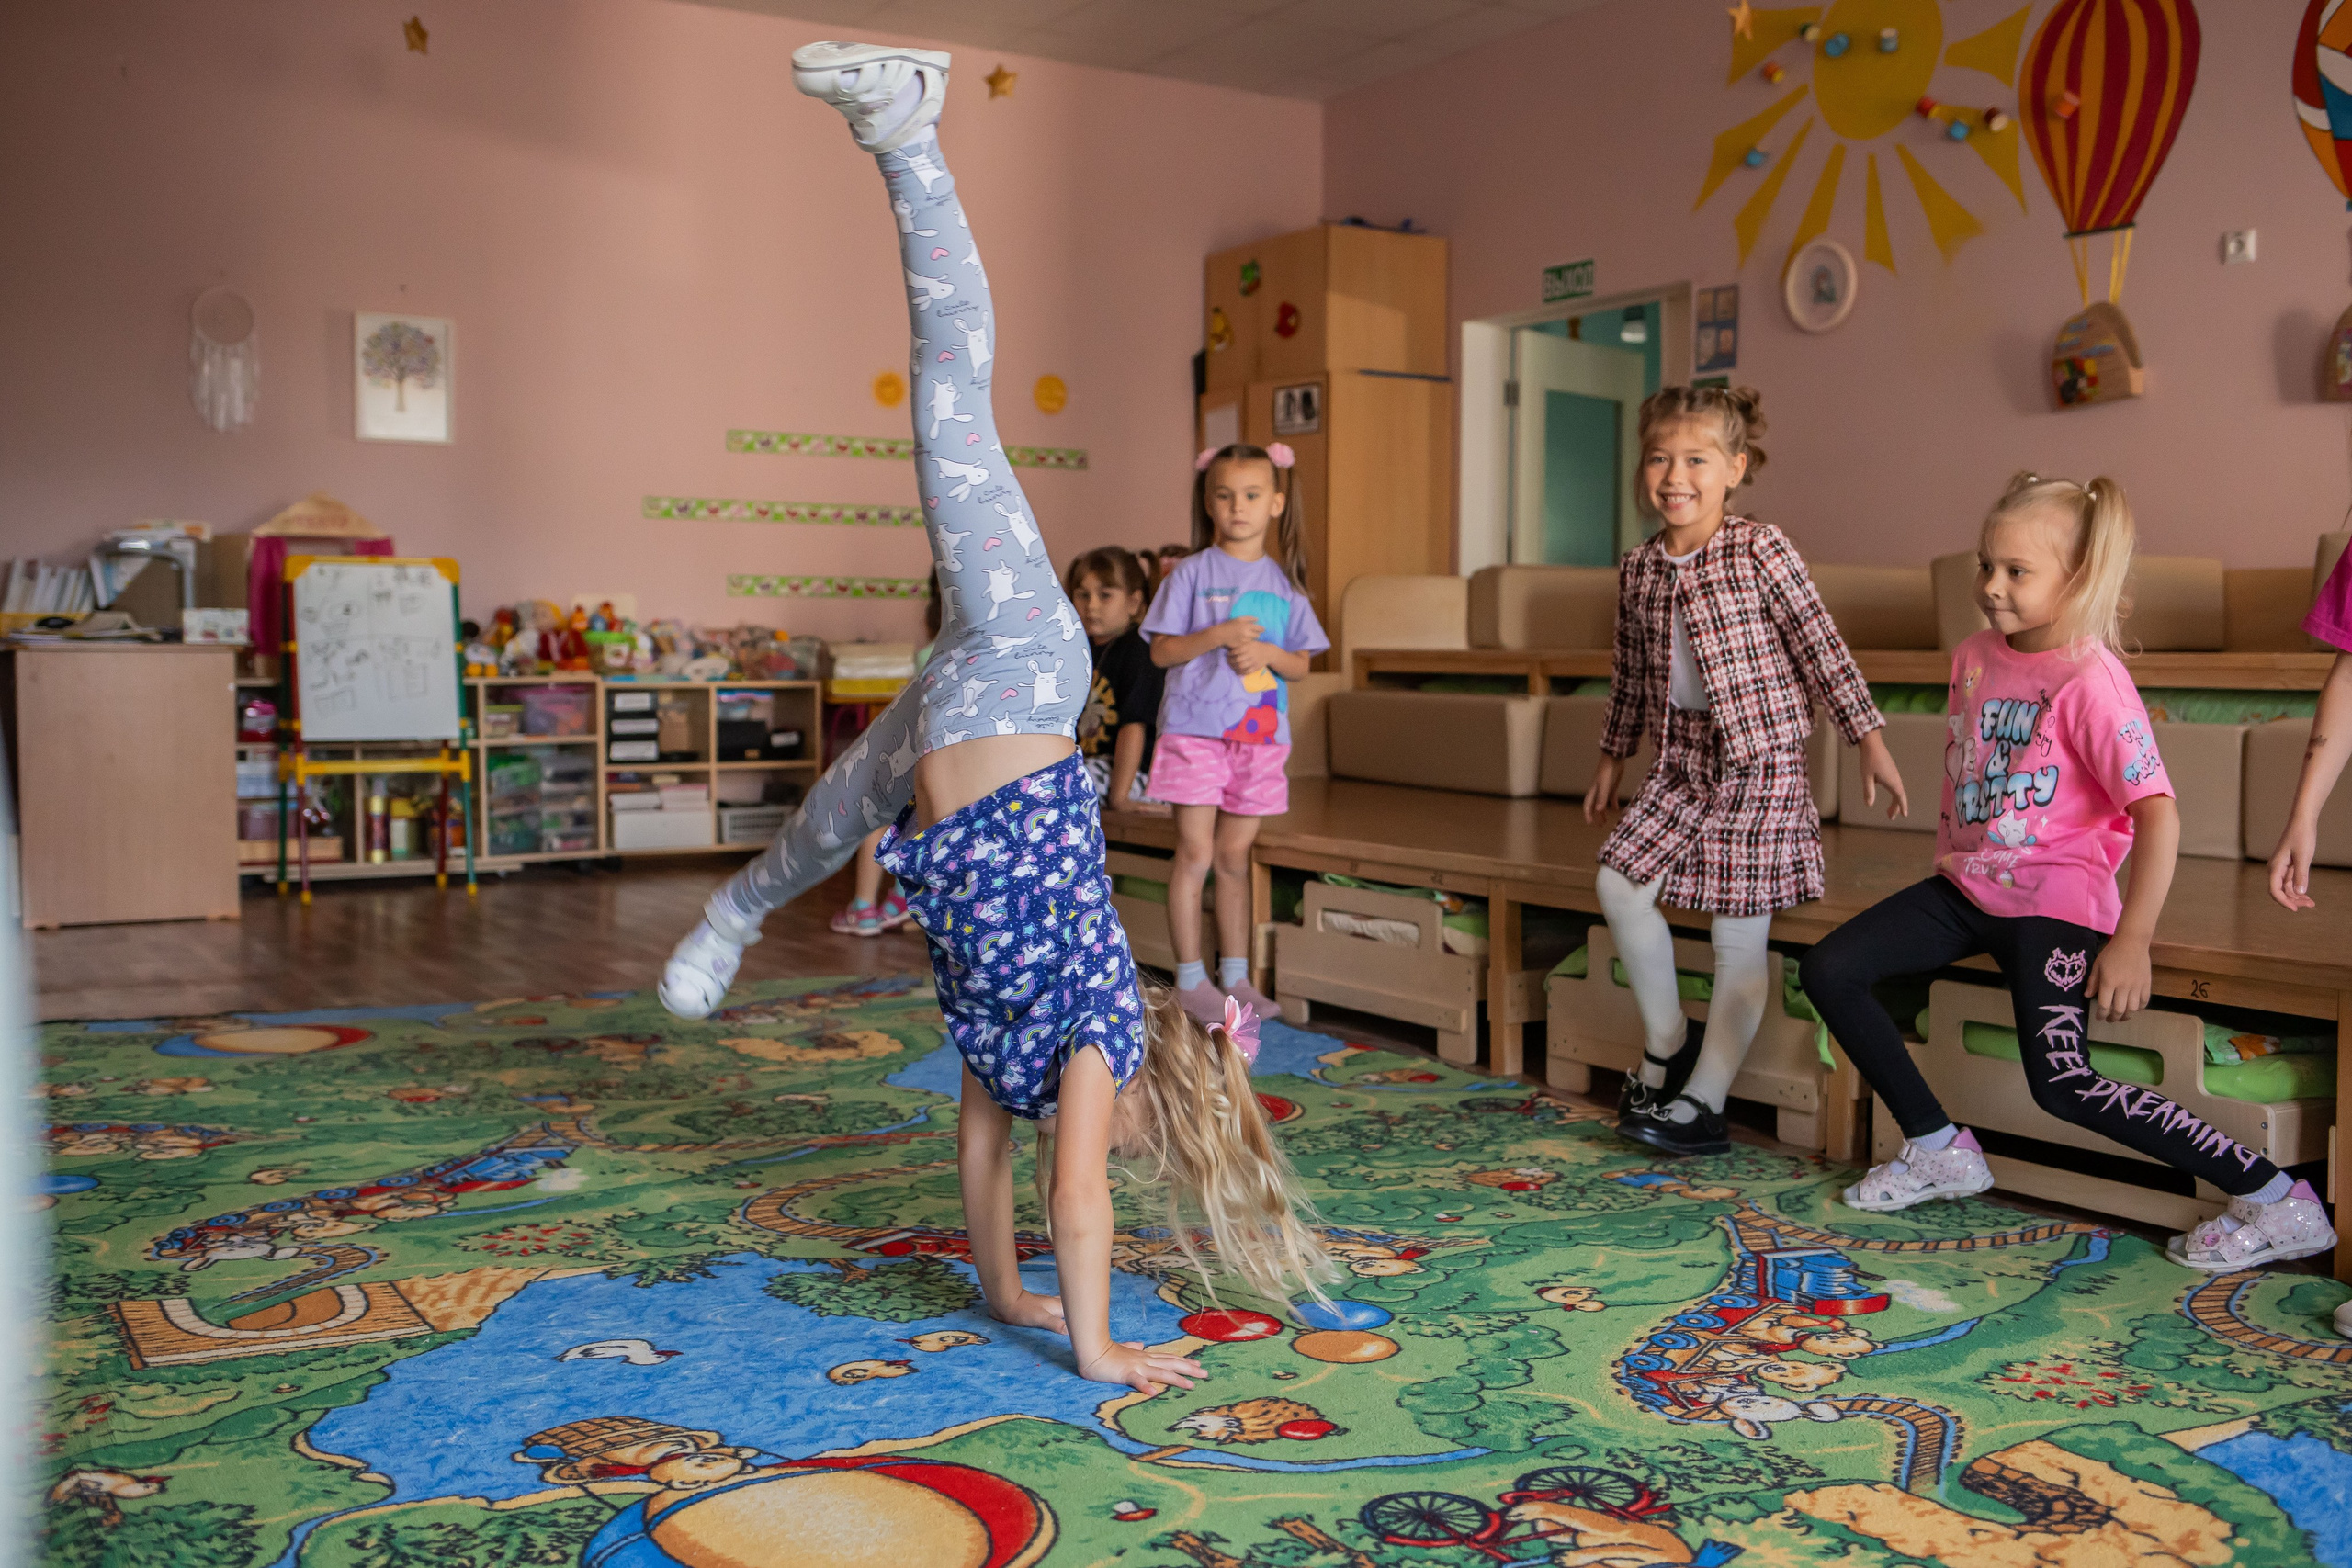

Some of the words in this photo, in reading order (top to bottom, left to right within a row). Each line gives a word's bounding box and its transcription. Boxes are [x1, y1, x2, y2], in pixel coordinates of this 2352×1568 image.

[1980, 697, 2041, 746] FUN
[1954, 764, 2060, 829] PRETTY
[2190, 979, 2211, 998] 26
[2075, 1076, 2261, 1172] DREAMING
